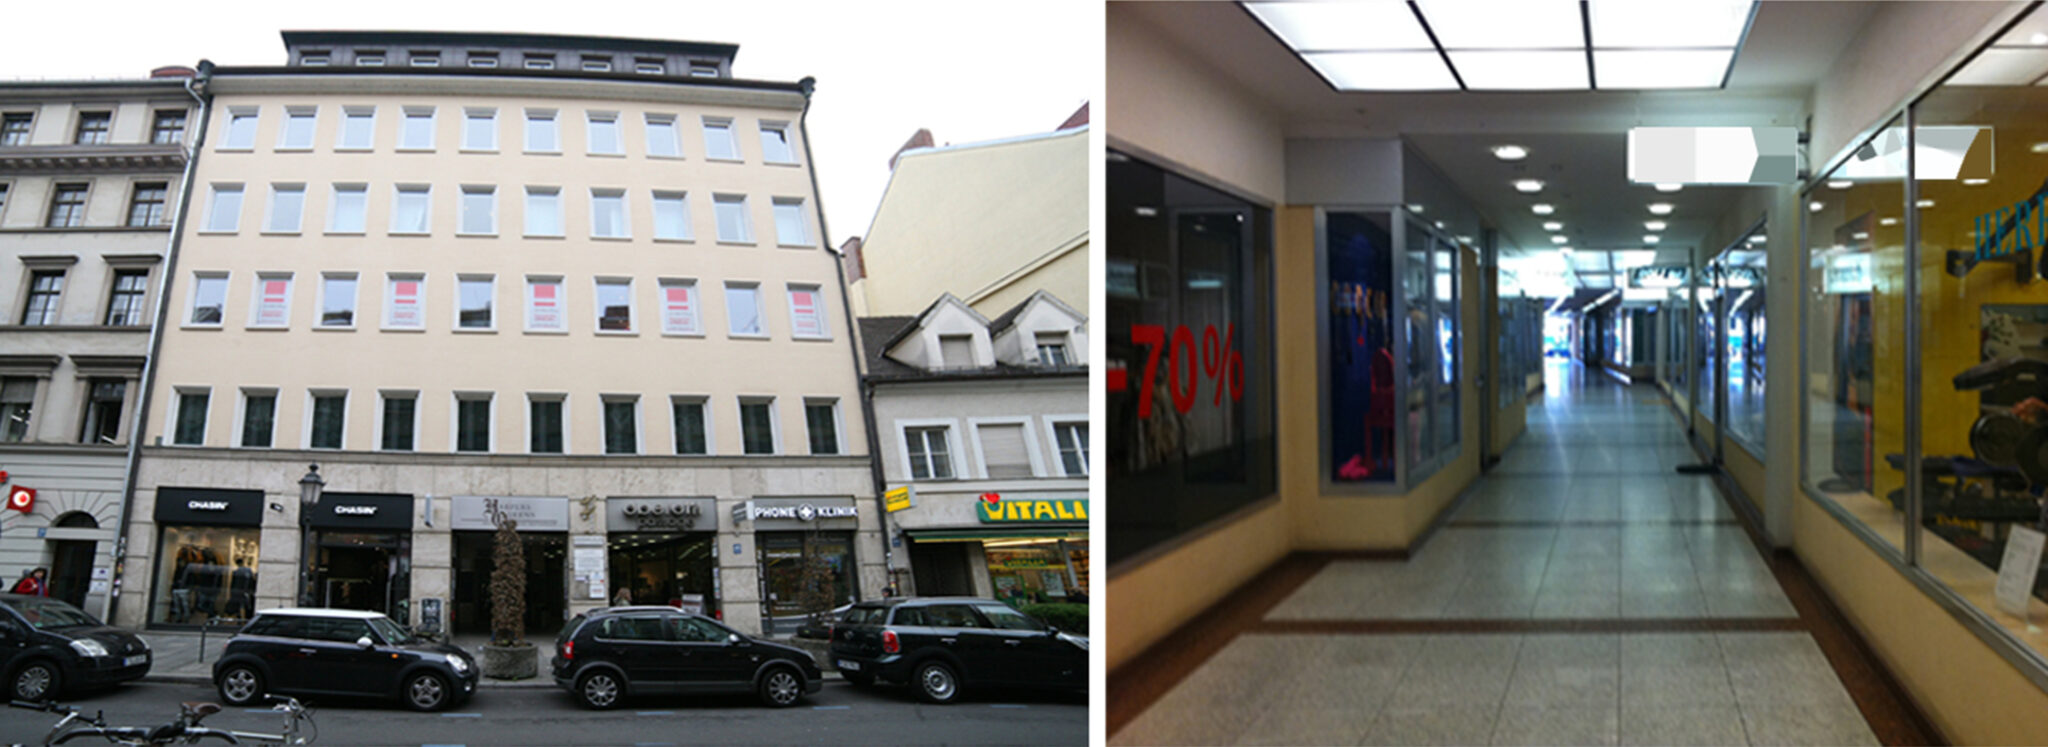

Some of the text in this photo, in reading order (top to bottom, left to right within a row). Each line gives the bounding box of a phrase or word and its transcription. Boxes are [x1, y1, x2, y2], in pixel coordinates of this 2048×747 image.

[1107, 322, 1244, 420] -70%
[754, 507, 797, 517] PHONE
[818, 507, 858, 517] KLINIK
